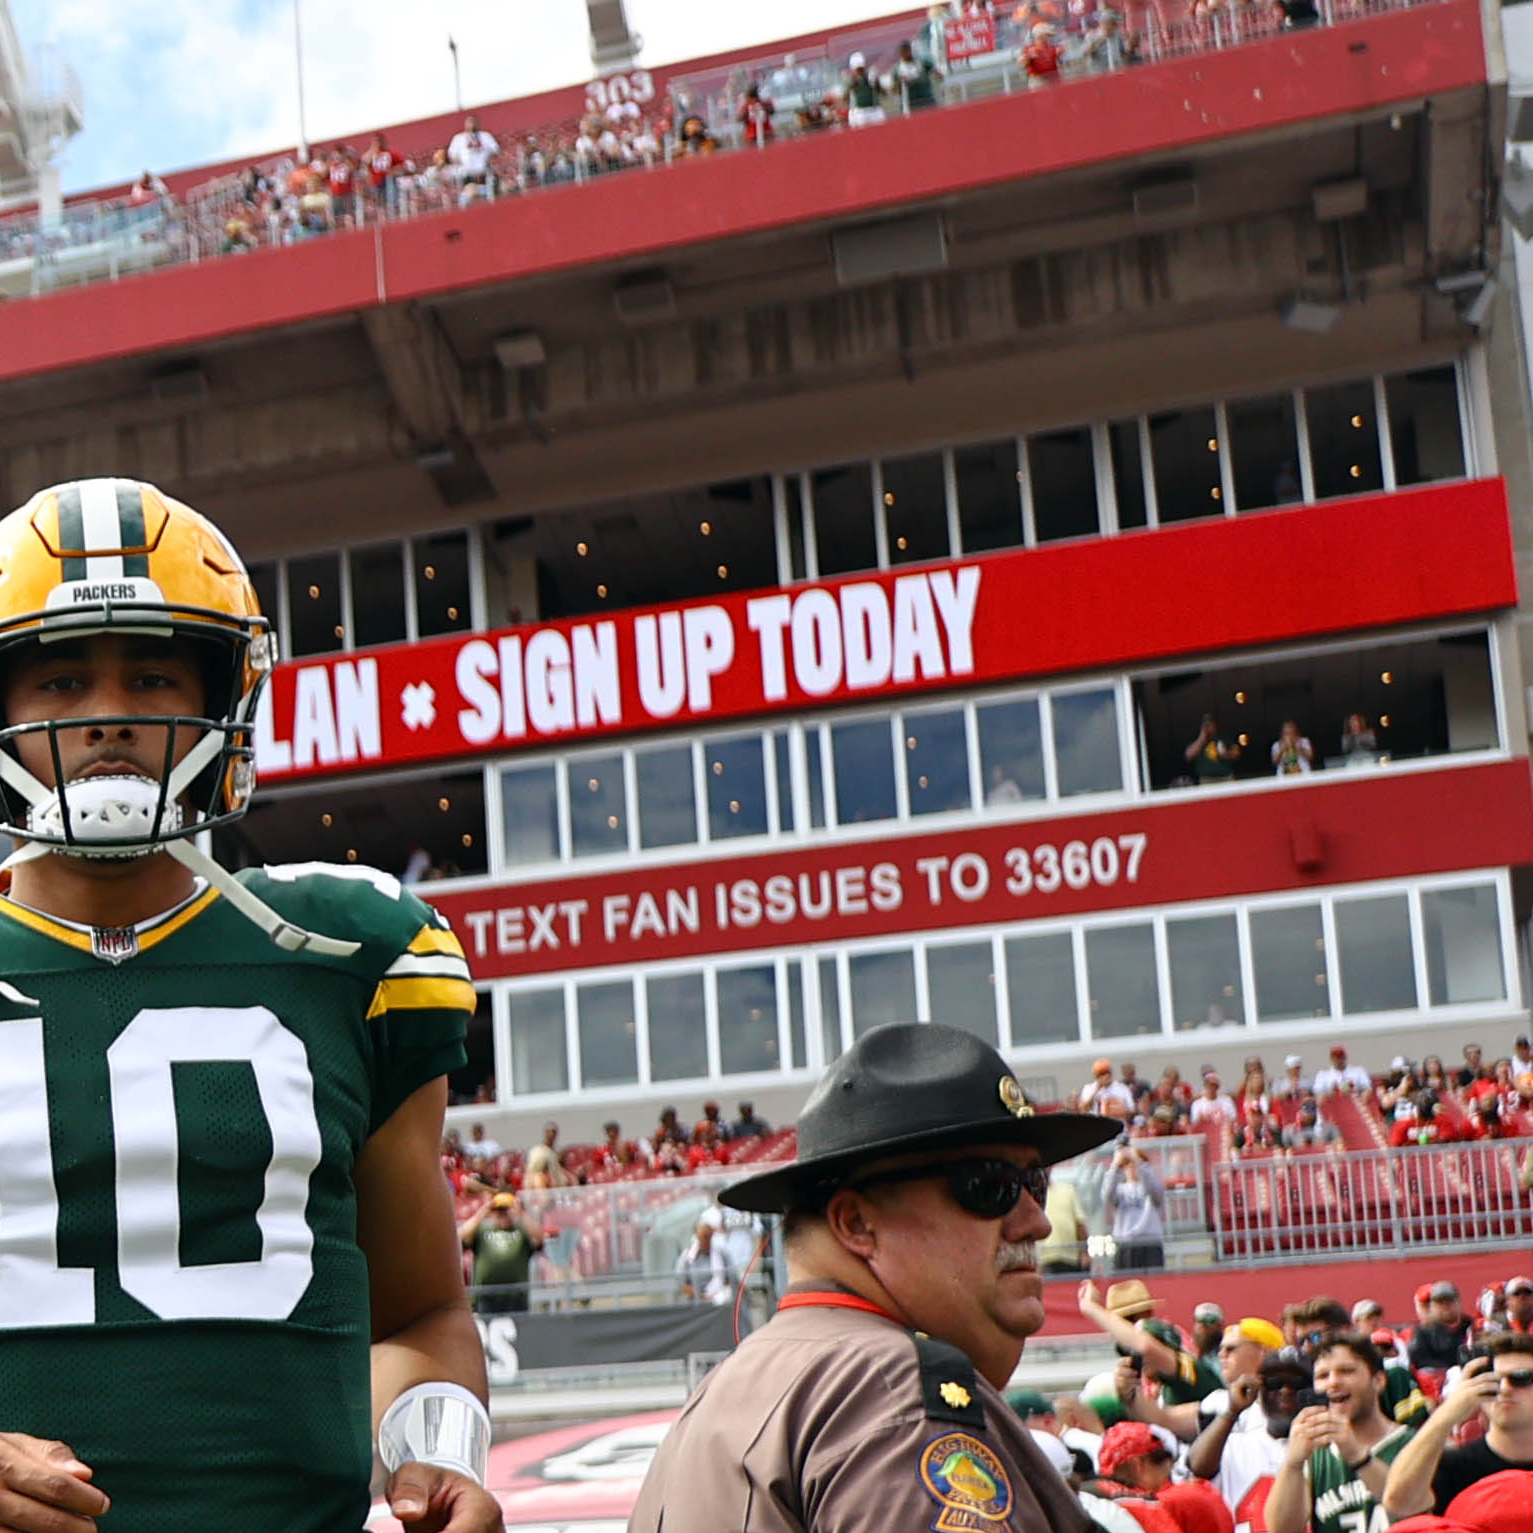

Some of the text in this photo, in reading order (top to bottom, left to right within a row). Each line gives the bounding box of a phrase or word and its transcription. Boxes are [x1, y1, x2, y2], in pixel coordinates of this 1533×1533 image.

[72, 582, 136, 603] PACKERS
[255, 656, 381, 772] LAN
[456, 620, 622, 746] SIGN
[635, 605, 735, 717] UP
[748, 565, 982, 702] TODAY
[465, 833, 1148, 957] TEXT FAN ISSUES TO 33607
[101, 934, 133, 955] NFL
